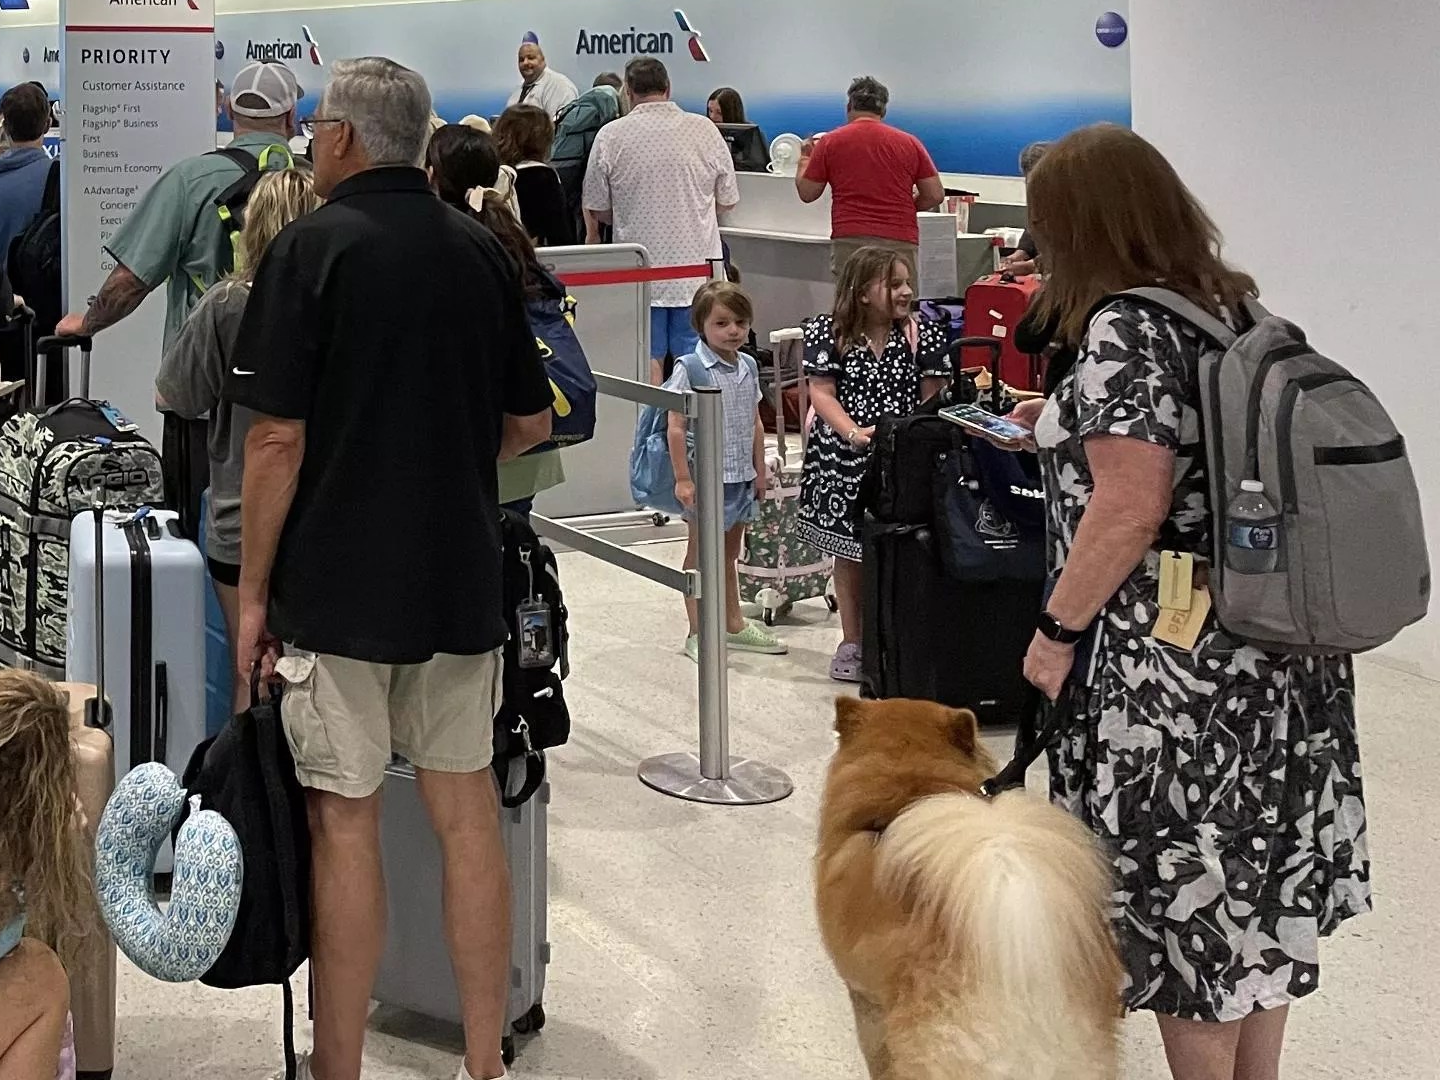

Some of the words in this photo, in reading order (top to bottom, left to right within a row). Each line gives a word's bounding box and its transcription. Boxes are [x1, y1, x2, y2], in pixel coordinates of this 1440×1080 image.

[576, 26, 673, 55] American
[246, 37, 302, 60] American
[81, 49, 171, 64] PRIORITY
[82, 80, 132, 91] Customer
[134, 80, 185, 91] Assistance
[123, 104, 141, 113] First
[123, 119, 159, 128] Business
[82, 134, 101, 143] First
[82, 149, 119, 158] Business
[83, 164, 121, 173] Premium
[124, 164, 163, 175] Economy
